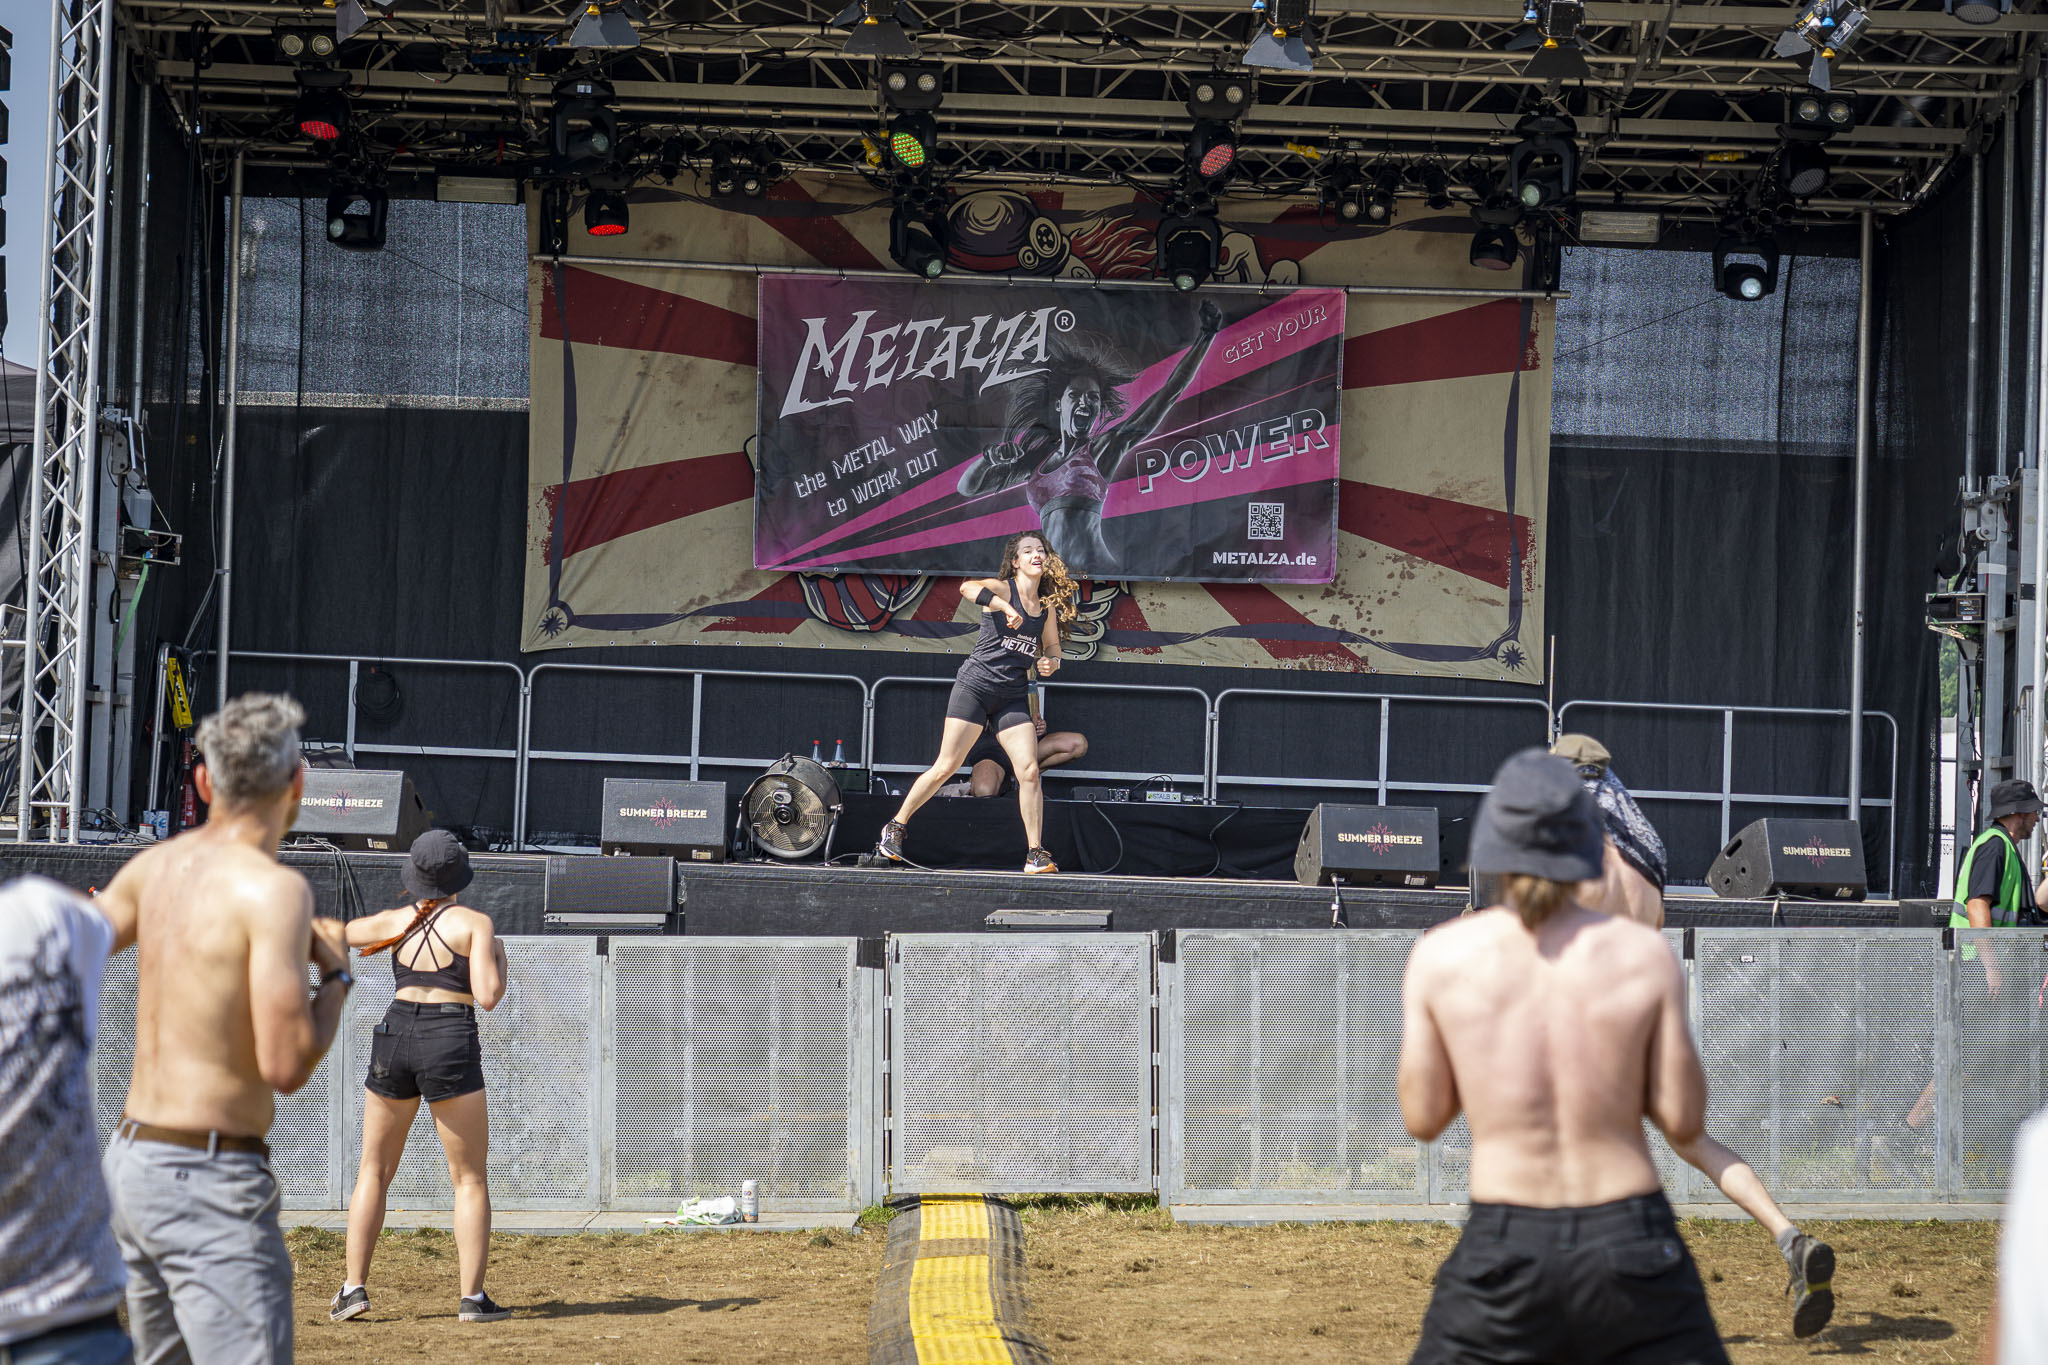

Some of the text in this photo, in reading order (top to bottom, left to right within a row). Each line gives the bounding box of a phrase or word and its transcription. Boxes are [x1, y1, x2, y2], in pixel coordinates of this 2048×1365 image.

[1221, 304, 1328, 364] GET YOUR
[794, 409, 939, 499] the METAL WAY
[1135, 408, 1330, 495] POWER
[827, 448, 939, 518] to WORK OUT
[1212, 550, 1317, 567] METALZA.de
[300, 797, 384, 809] SUMMER BREEZE
[619, 807, 708, 819] SUMMER BREEZE
[1337, 832, 1424, 845] SUMMER BREEZE
[1782, 846, 1852, 858] SUMMER BREEZE
